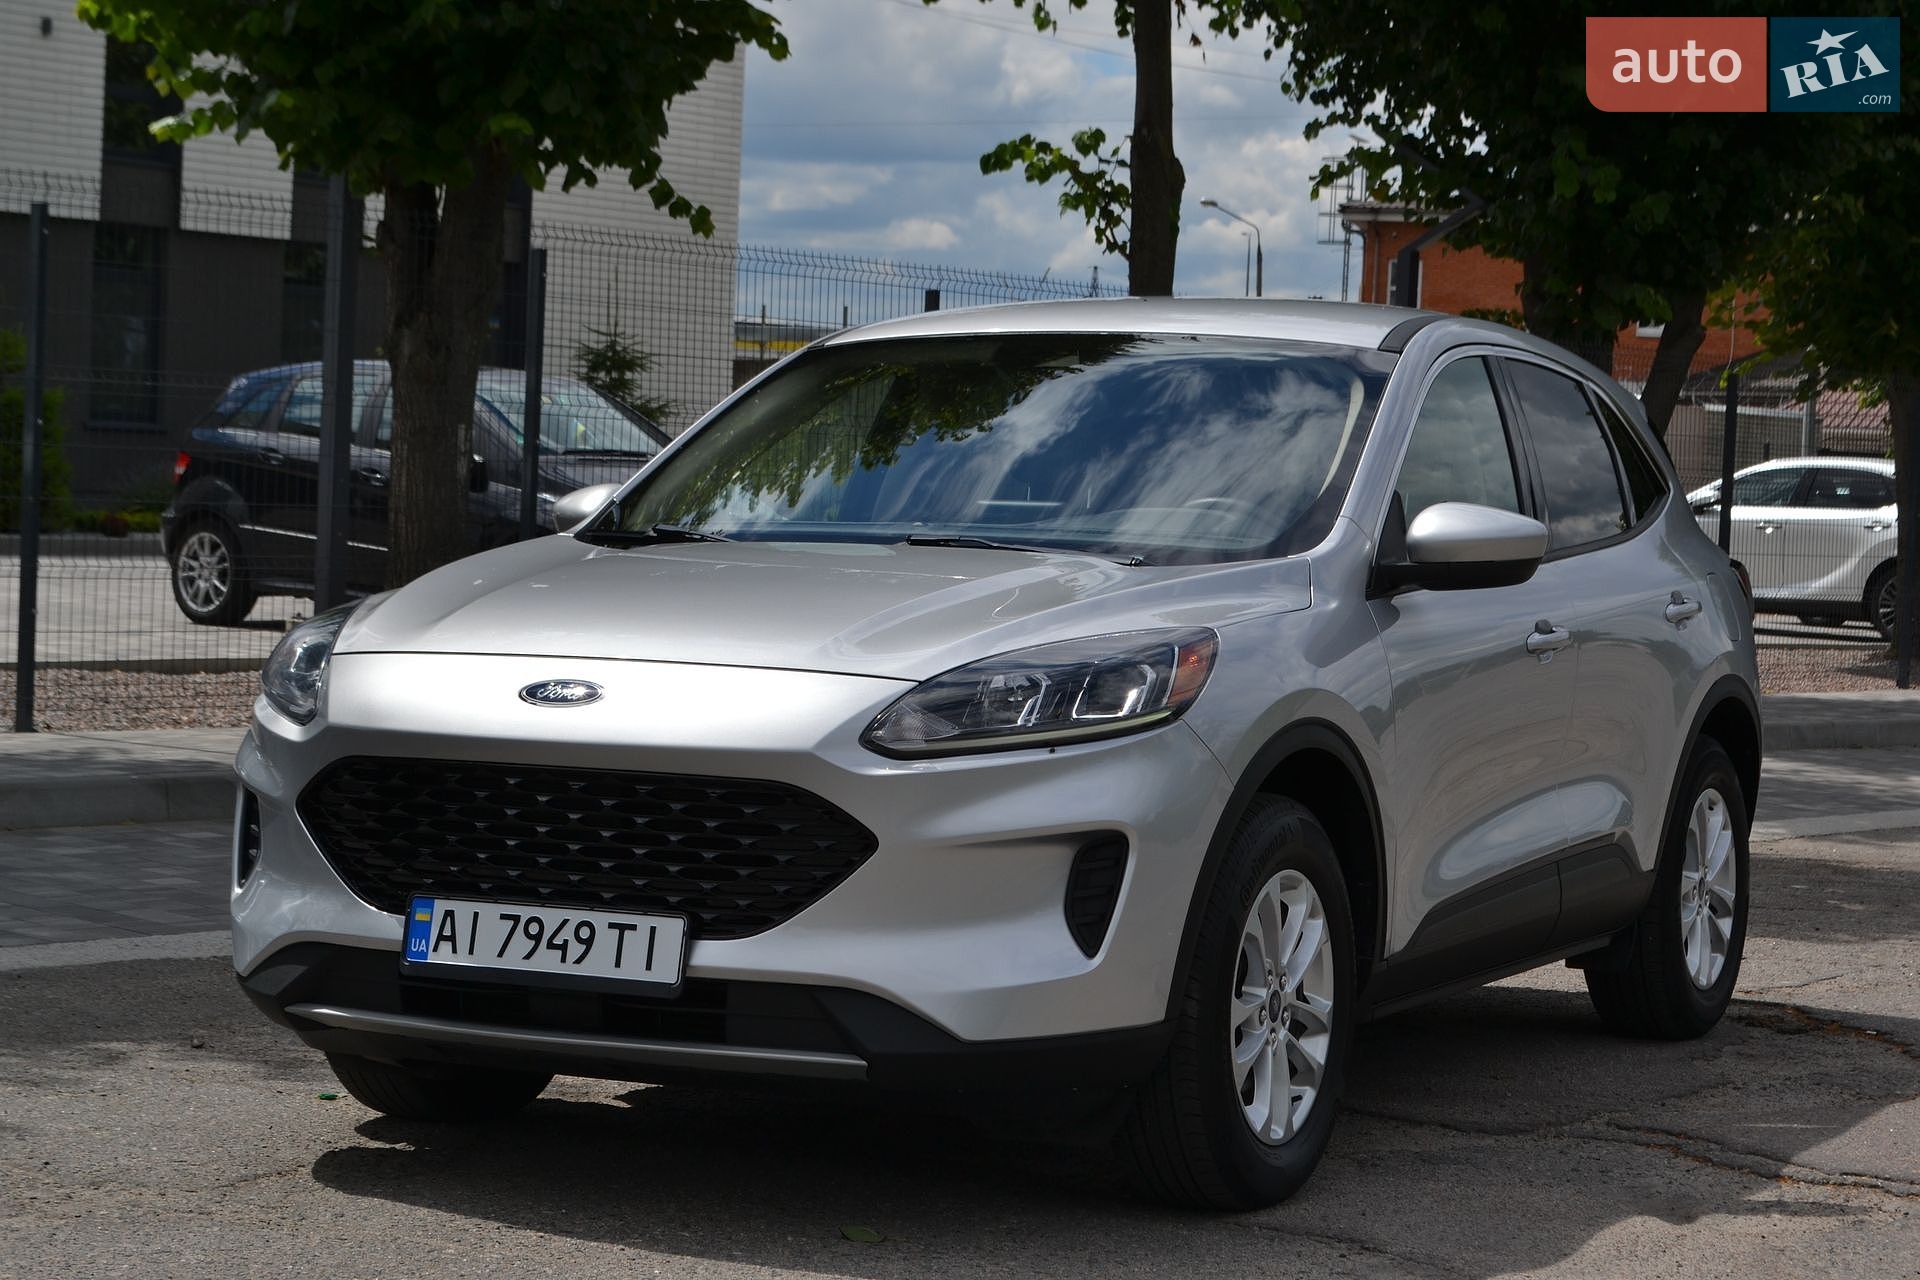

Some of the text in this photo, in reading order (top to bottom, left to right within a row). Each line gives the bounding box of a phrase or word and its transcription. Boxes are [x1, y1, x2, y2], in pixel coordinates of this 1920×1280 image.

[411, 937, 427, 952] UA
[432, 909, 657, 971] AI 7949 TI
